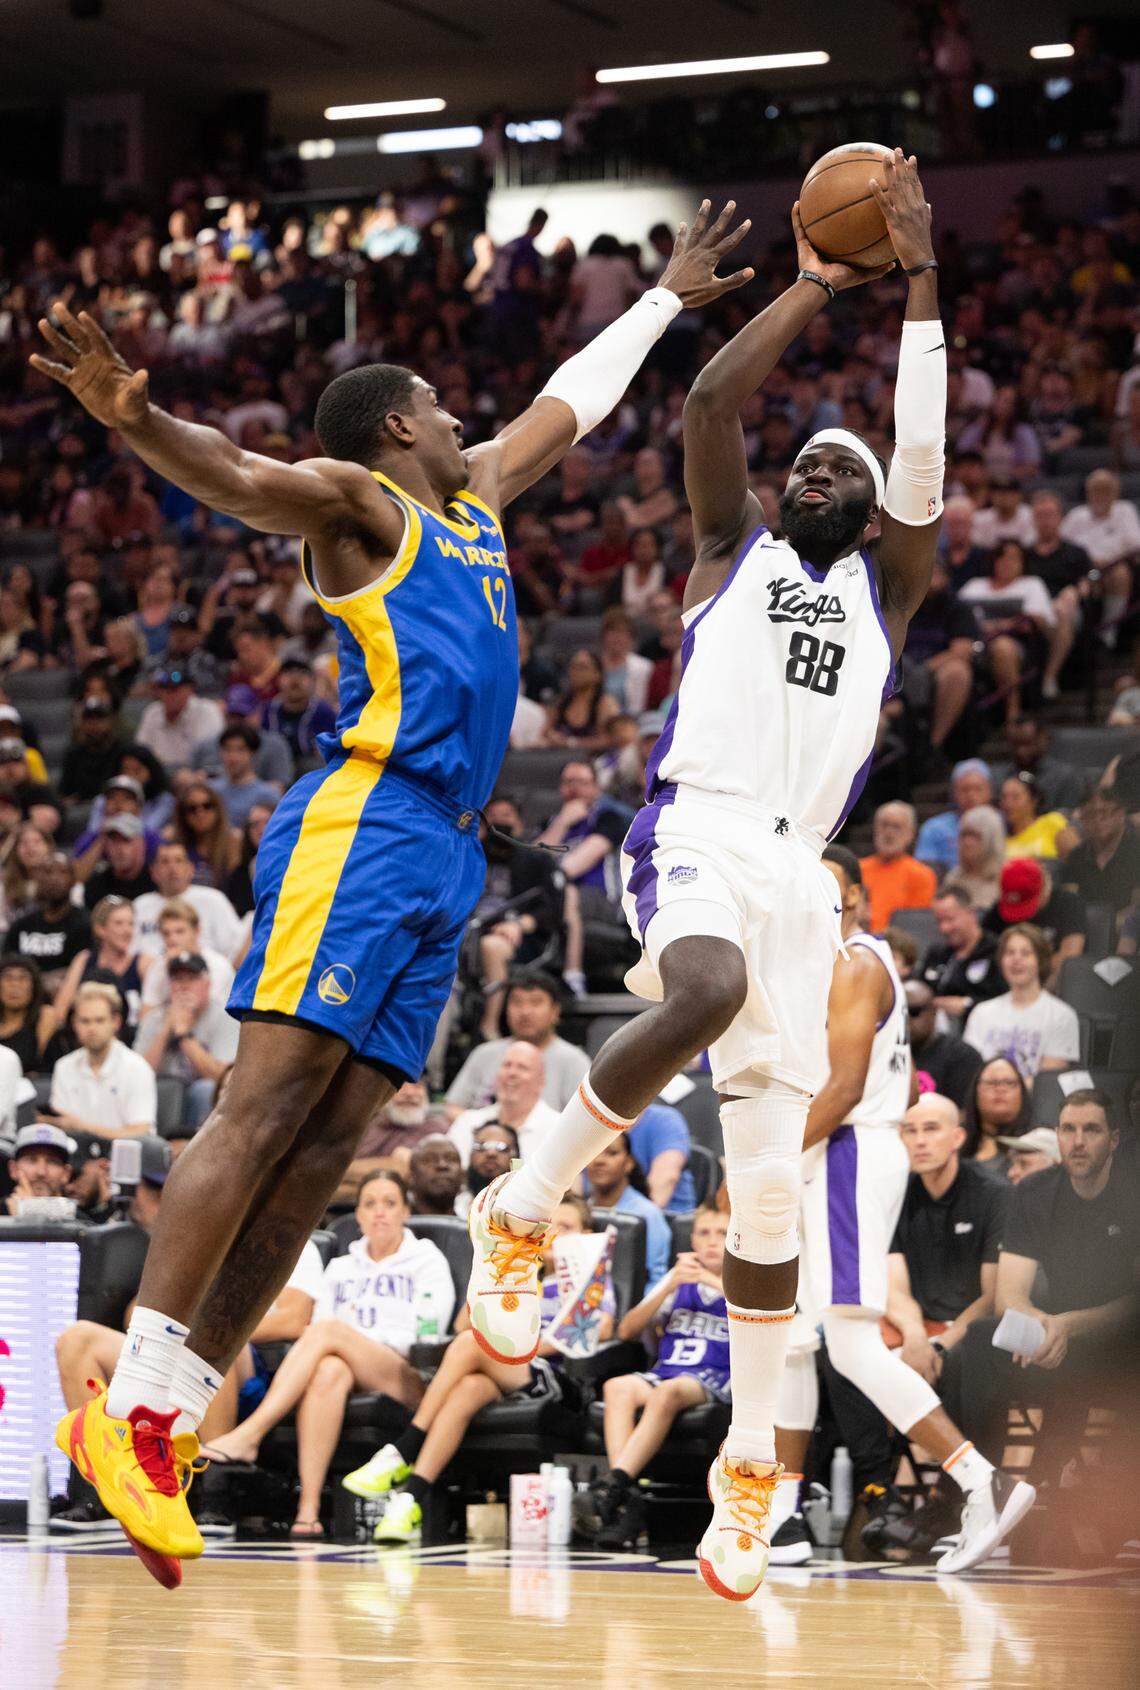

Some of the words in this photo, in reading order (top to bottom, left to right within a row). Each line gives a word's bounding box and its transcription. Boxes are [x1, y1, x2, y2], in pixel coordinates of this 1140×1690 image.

[482, 575, 507, 632] 12
[766, 577, 847, 627] Kings
[786, 631, 846, 697] 88
